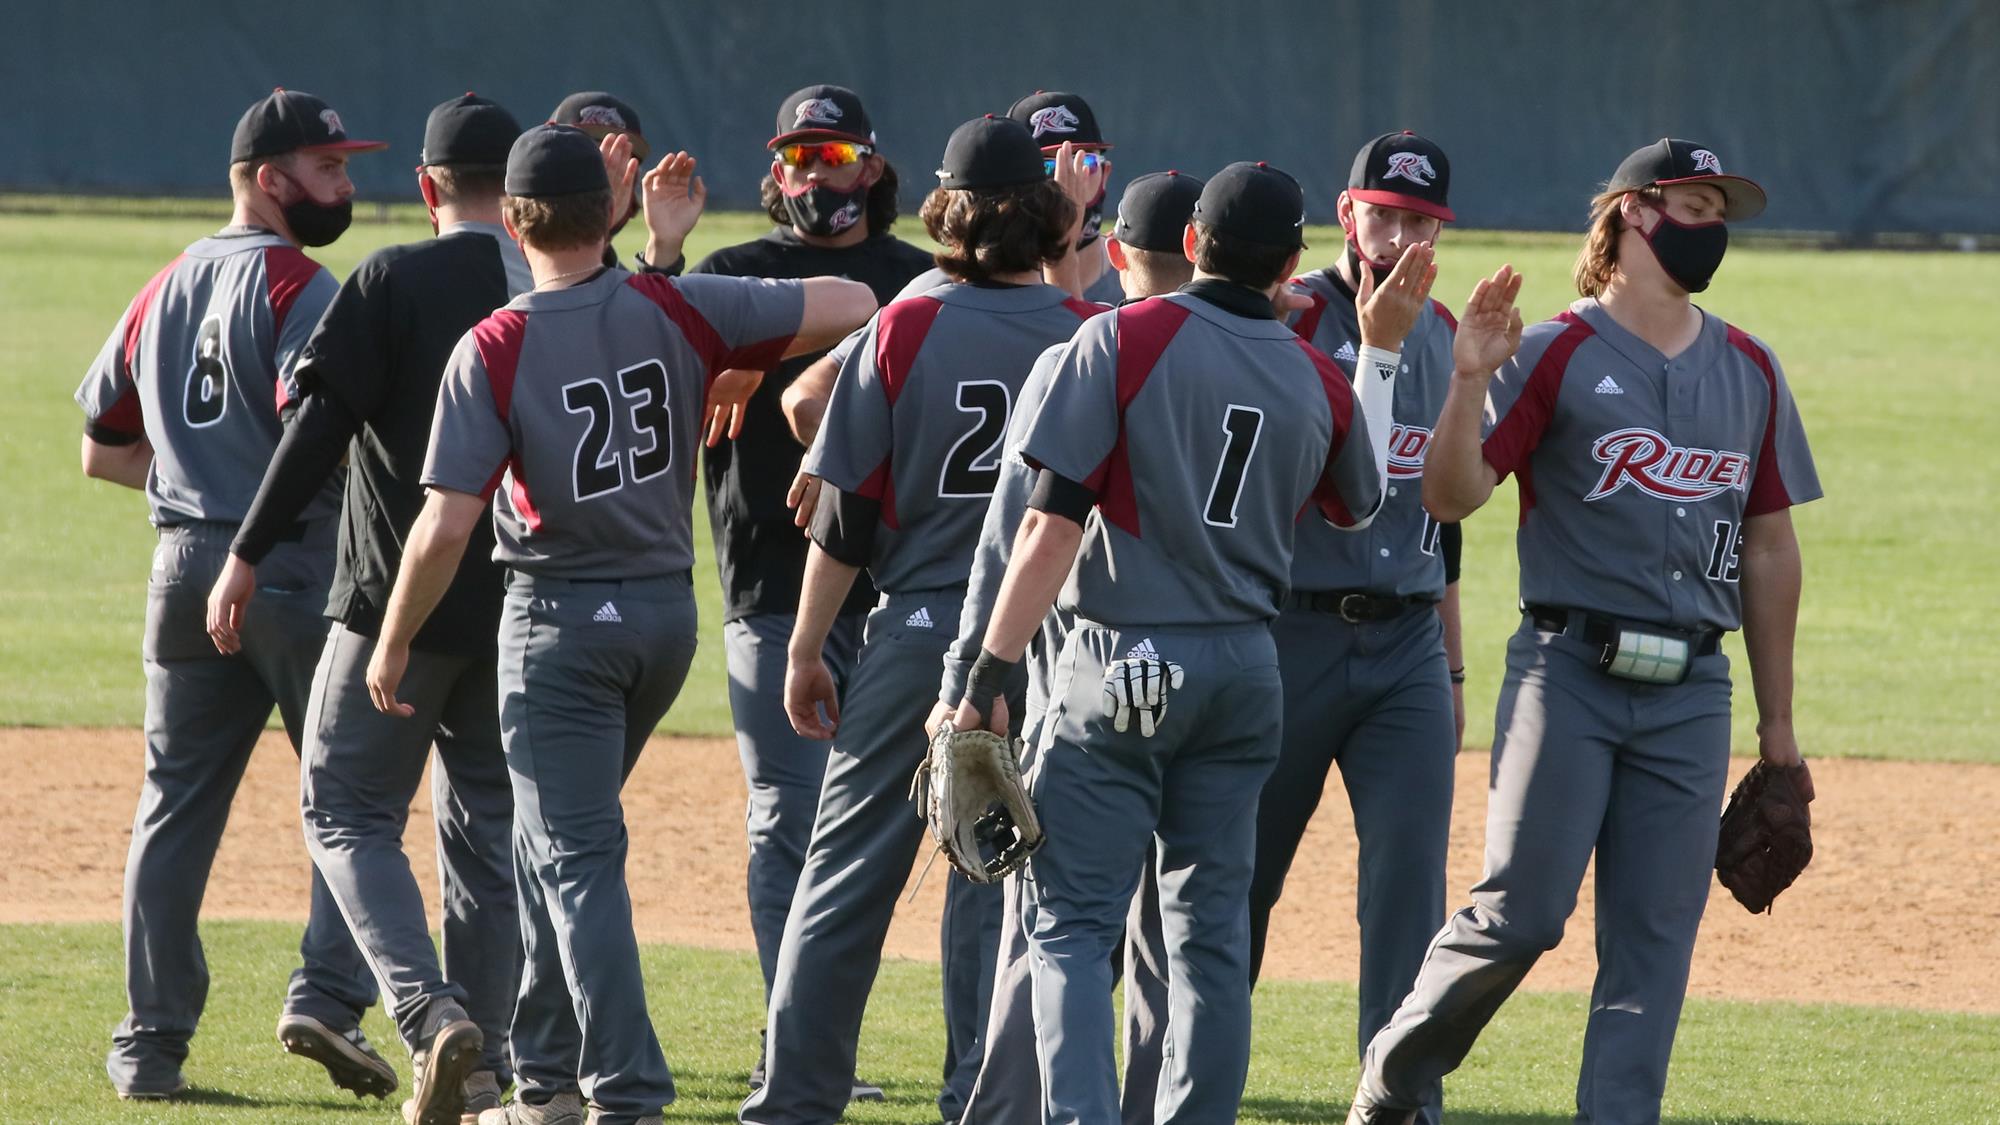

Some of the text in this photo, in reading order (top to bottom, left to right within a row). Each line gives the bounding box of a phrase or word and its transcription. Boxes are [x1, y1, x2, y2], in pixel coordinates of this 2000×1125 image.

[1030, 106, 1076, 139] R
[1383, 152, 1431, 186] R
[1690, 149, 1723, 175] R
[183, 313, 227, 428] 8
[1594, 386, 1624, 394] adidas
[561, 358, 673, 503] 23
[1202, 403, 1265, 529] 1
[593, 614, 622, 623] adidas
[906, 618, 934, 628] adidas
[1127, 649, 1160, 660] adidas
